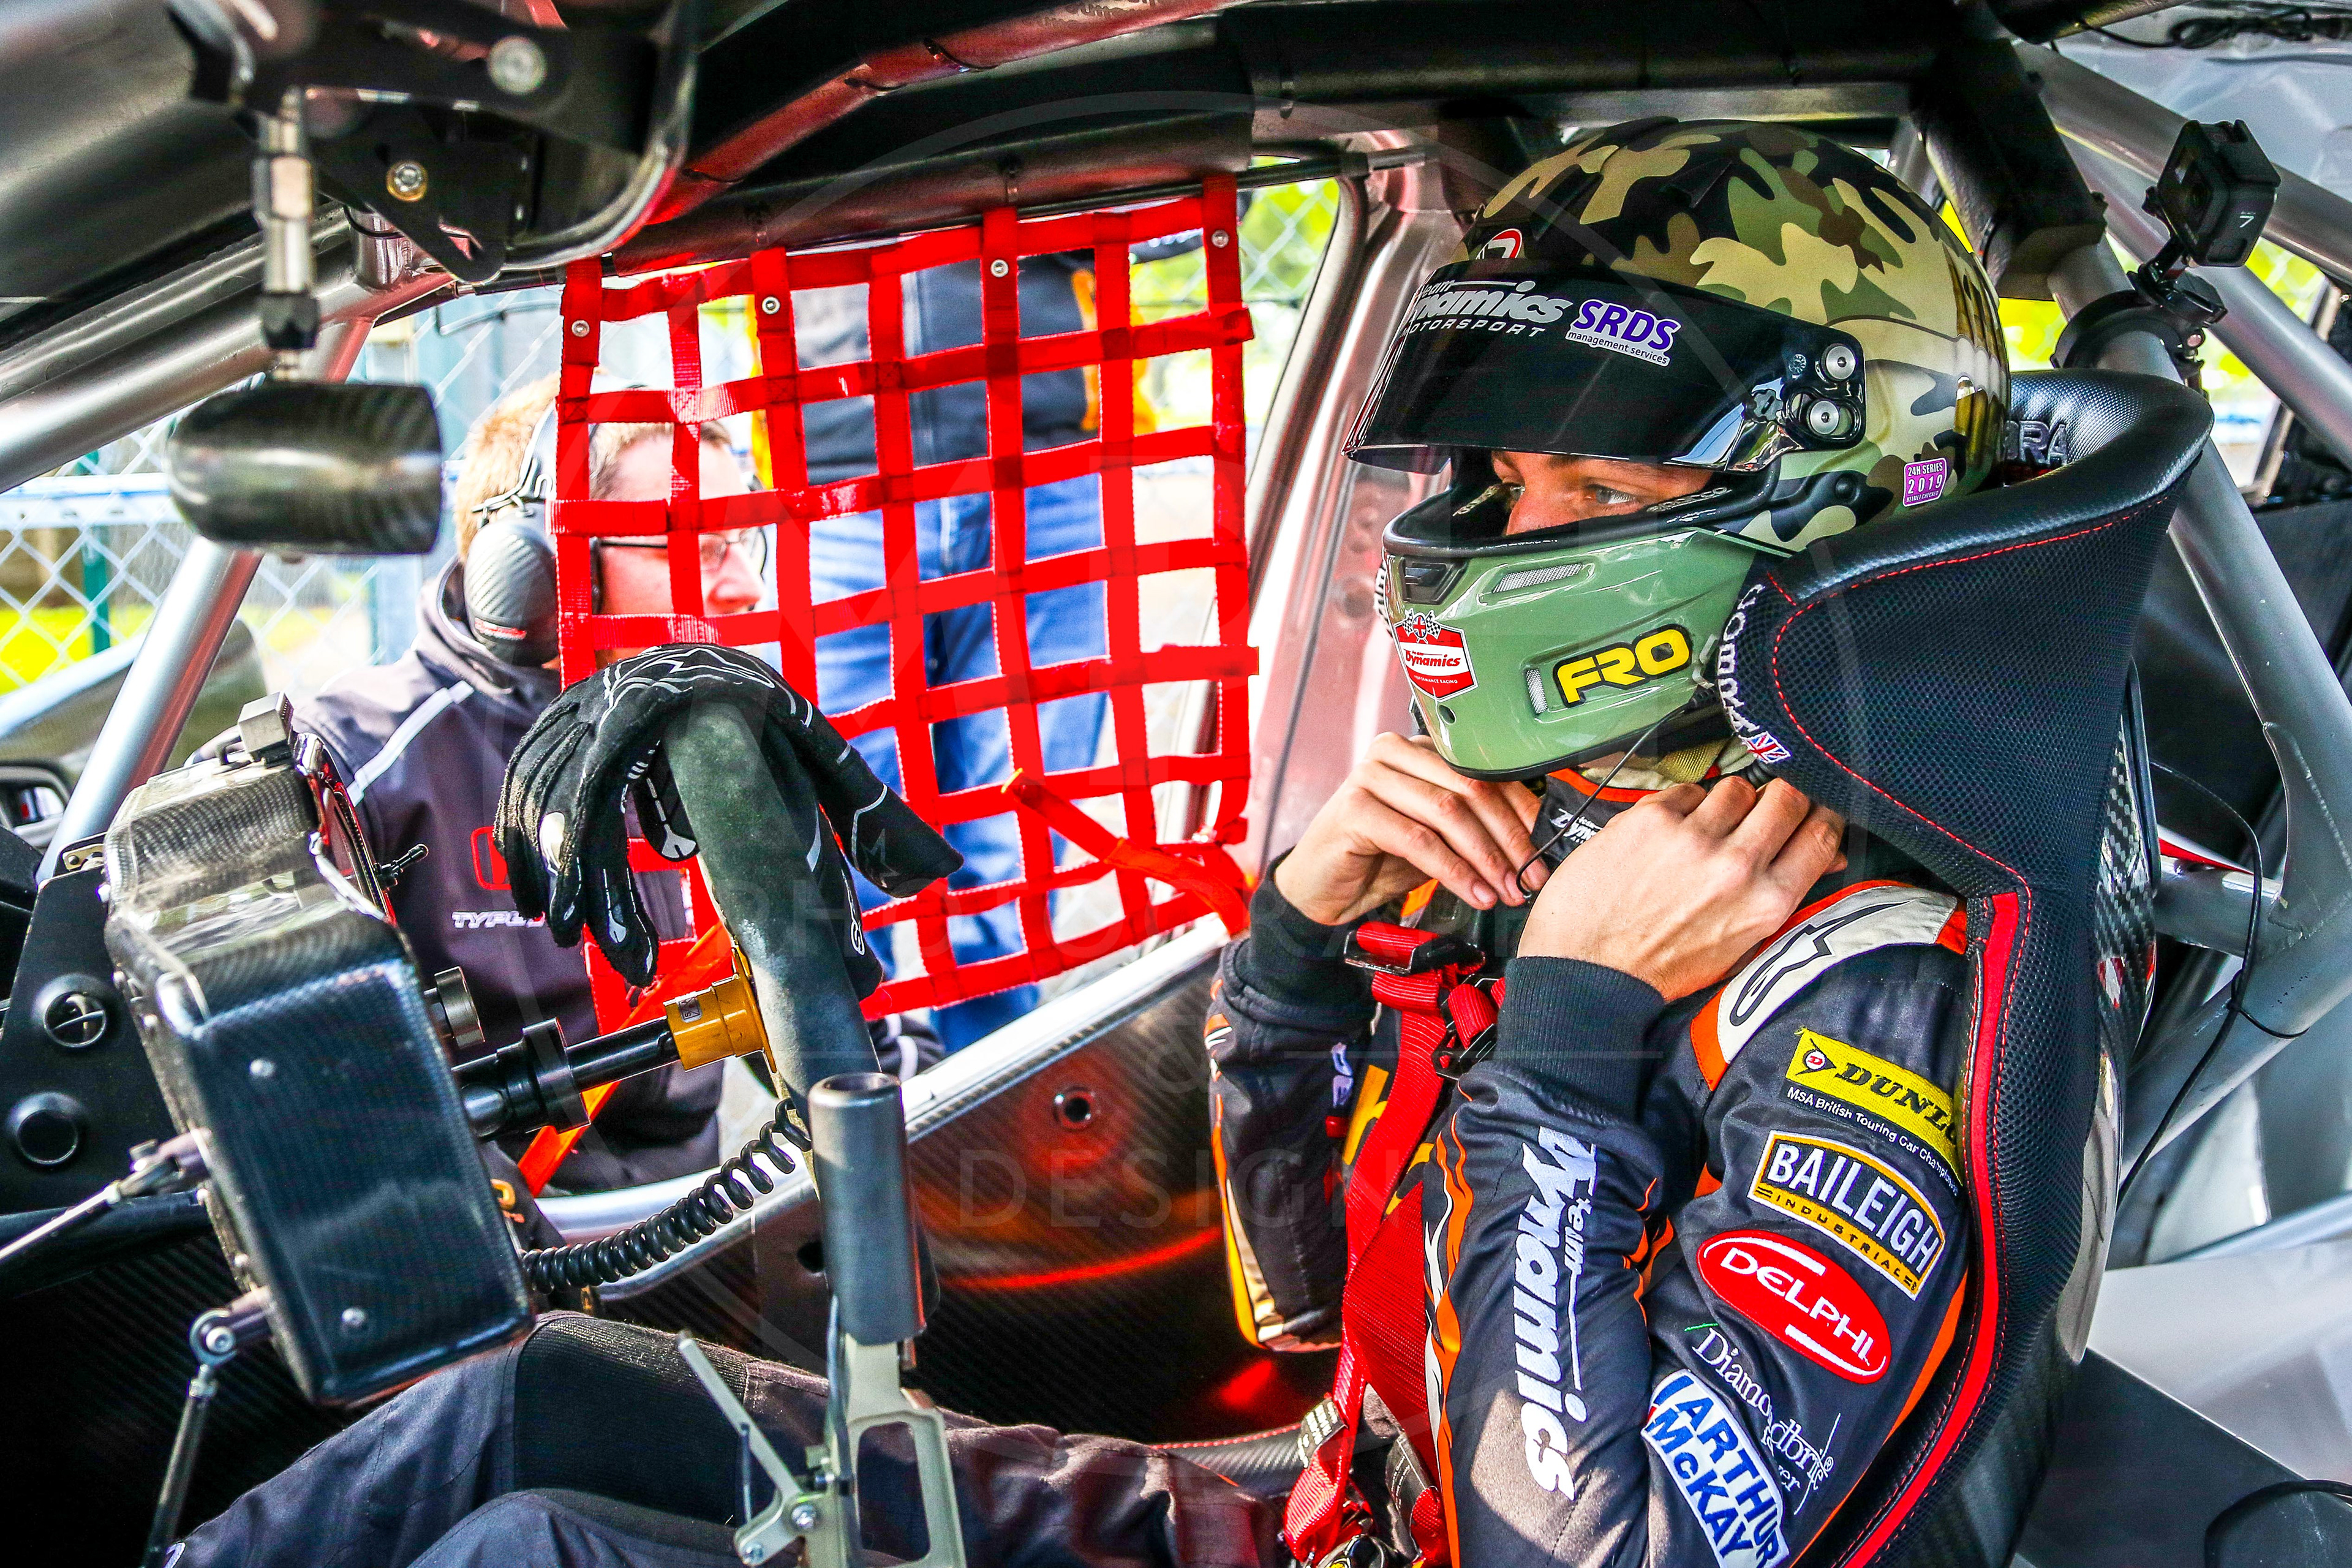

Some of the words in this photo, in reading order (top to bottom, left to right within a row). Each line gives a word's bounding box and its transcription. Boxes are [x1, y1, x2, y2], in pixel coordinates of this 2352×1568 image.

[1568, 331, 1629, 352] management
[1630, 347, 1667, 364] services
[1573, 301, 1678, 350] SRDS
[1907, 466, 1921, 477] 24H
[1922, 462, 1943, 475] SERIES
[1907, 474, 1943, 494] 2019
[1404, 649, 1461, 667] Dynamics
[1556, 628, 1690, 704] FRO
[1717, 584, 1766, 733] COBRA
[1787, 1087, 1814, 1107] MSA
[1815, 1098, 1853, 1119] British
[1855, 1112, 1898, 1143] Touring
[1899, 1135, 1919, 1153] Car
[1767, 1143, 1939, 1273] BAILEIGH
[1776, 1194, 1901, 1276] INDUSTRIAL
[1513, 1125, 1597, 1501] Dynamics
[1720, 1247, 1874, 1361] DELPHI
[1645, 1408, 1754, 1559] McKAY
[1676, 1397, 1779, 1568] ARTHUR
